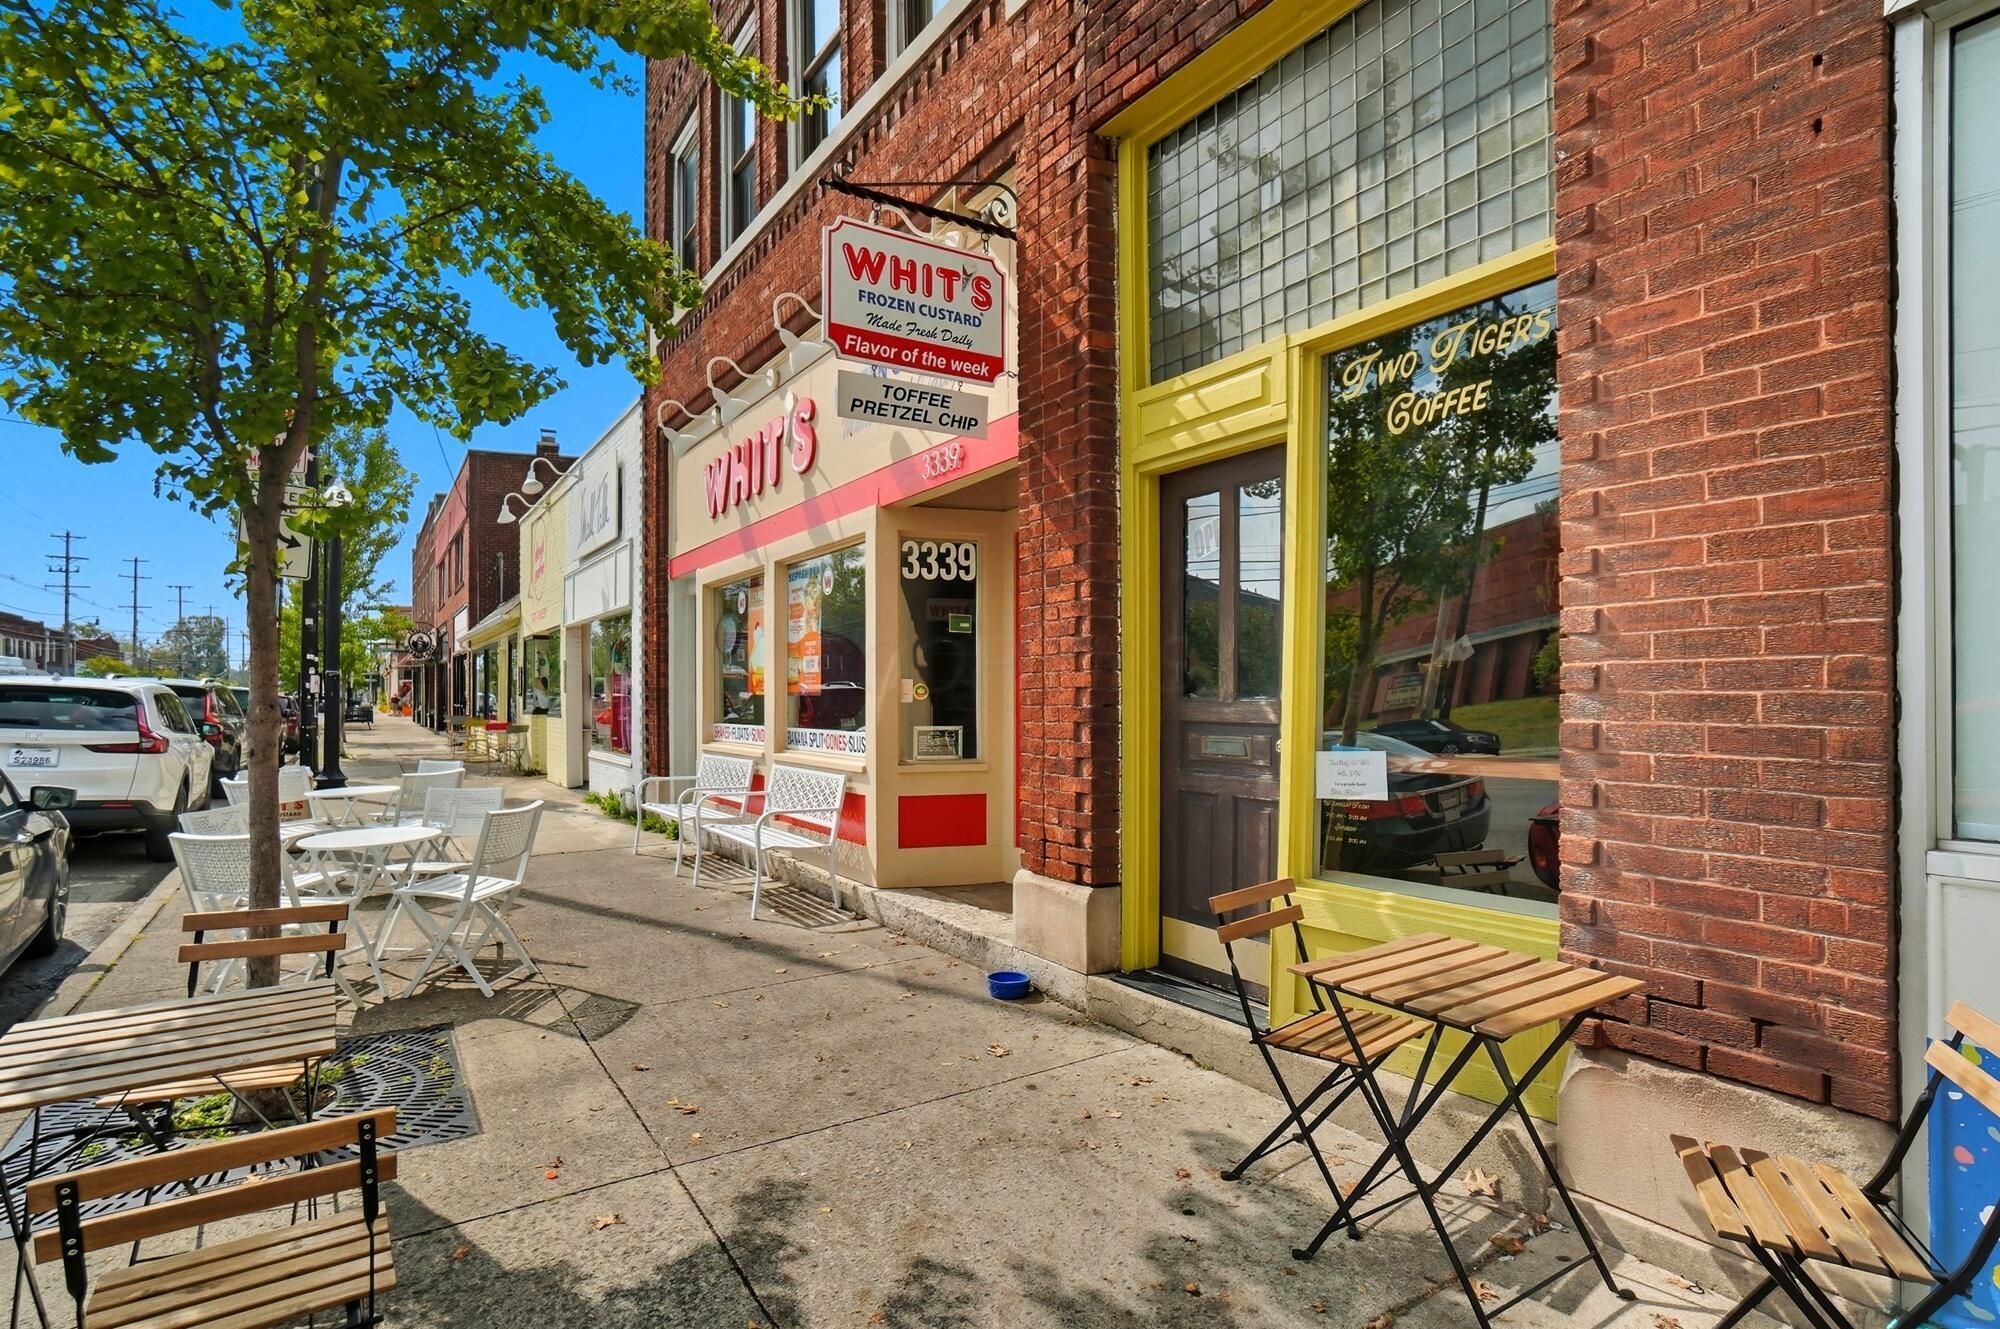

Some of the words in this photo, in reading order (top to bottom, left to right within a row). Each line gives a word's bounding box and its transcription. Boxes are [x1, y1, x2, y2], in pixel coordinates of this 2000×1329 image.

[842, 242, 993, 312] WHIT'S
[858, 289, 916, 314] FROZEN
[866, 312, 902, 332] Made
[905, 322, 938, 339] Fresh
[941, 329, 974, 350] Daily
[844, 334, 898, 359] Flavor
[901, 348, 919, 364] of
[921, 353, 947, 369] the
[950, 359, 990, 377] week
[850, 397, 933, 425] PRETZEL
[938, 411, 979, 432] CHIP
[882, 384, 953, 410] TOFFEE
[921, 442, 960, 480] 3339
[901, 540, 976, 581] 3339
[787, 731, 808, 747] BANANA
[809, 732, 824, 748] SPLIT
[826, 733, 847, 751] CONES
